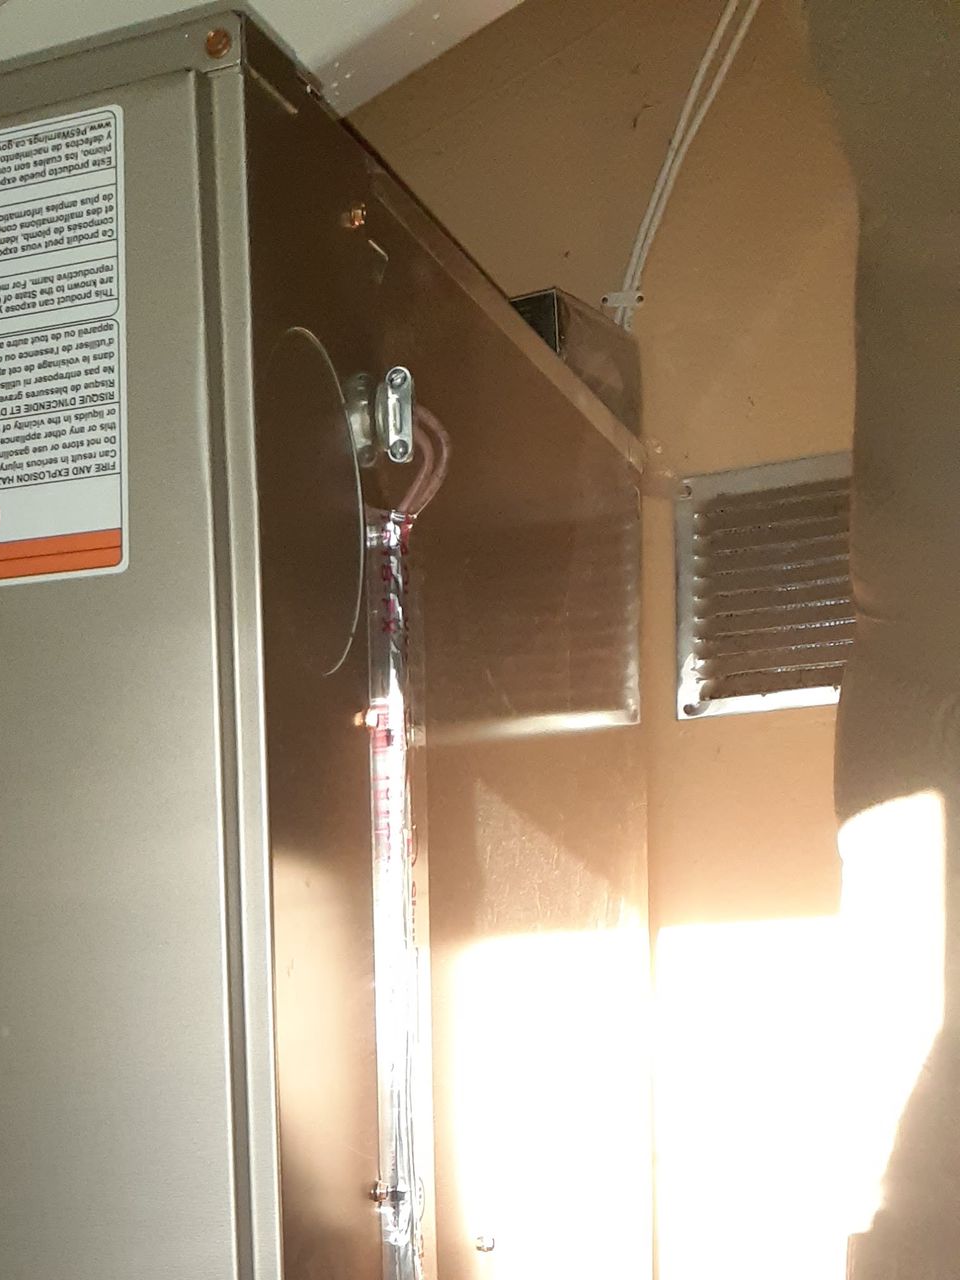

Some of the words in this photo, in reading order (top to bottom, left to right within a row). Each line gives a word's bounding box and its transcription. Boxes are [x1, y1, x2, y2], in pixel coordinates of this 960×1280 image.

[55, 261, 114, 284] reproductive
[11, 279, 27, 292] For
[66, 278, 97, 294] known
[98, 275, 114, 286] are
[13, 289, 37, 303] State
[38, 286, 54, 299] the
[55, 288, 92, 307] product
[93, 287, 113, 300] This
[3, 298, 37, 314] expose
[37, 297, 55, 308] can
[78, 390, 115, 405] RISQUE
[22, 396, 76, 413] D'INCENDIE
[46, 415, 61, 427] the
[72, 406, 104, 423] liquids
[12, 415, 45, 432] vicinity
[68, 423, 85, 436] any
[98, 421, 116, 433] this
[43, 428, 67, 441] other
[31, 444, 48, 454] use
[60, 439, 85, 452] store
[85, 436, 102, 449] not
[70, 450, 97, 464] result
[97, 448, 117, 460] Can
[25, 456, 58, 470] serious
[93, 461, 116, 473] FIRE
[15, 467, 70, 483] EXPLOSION
[70, 464, 92, 476] AND
